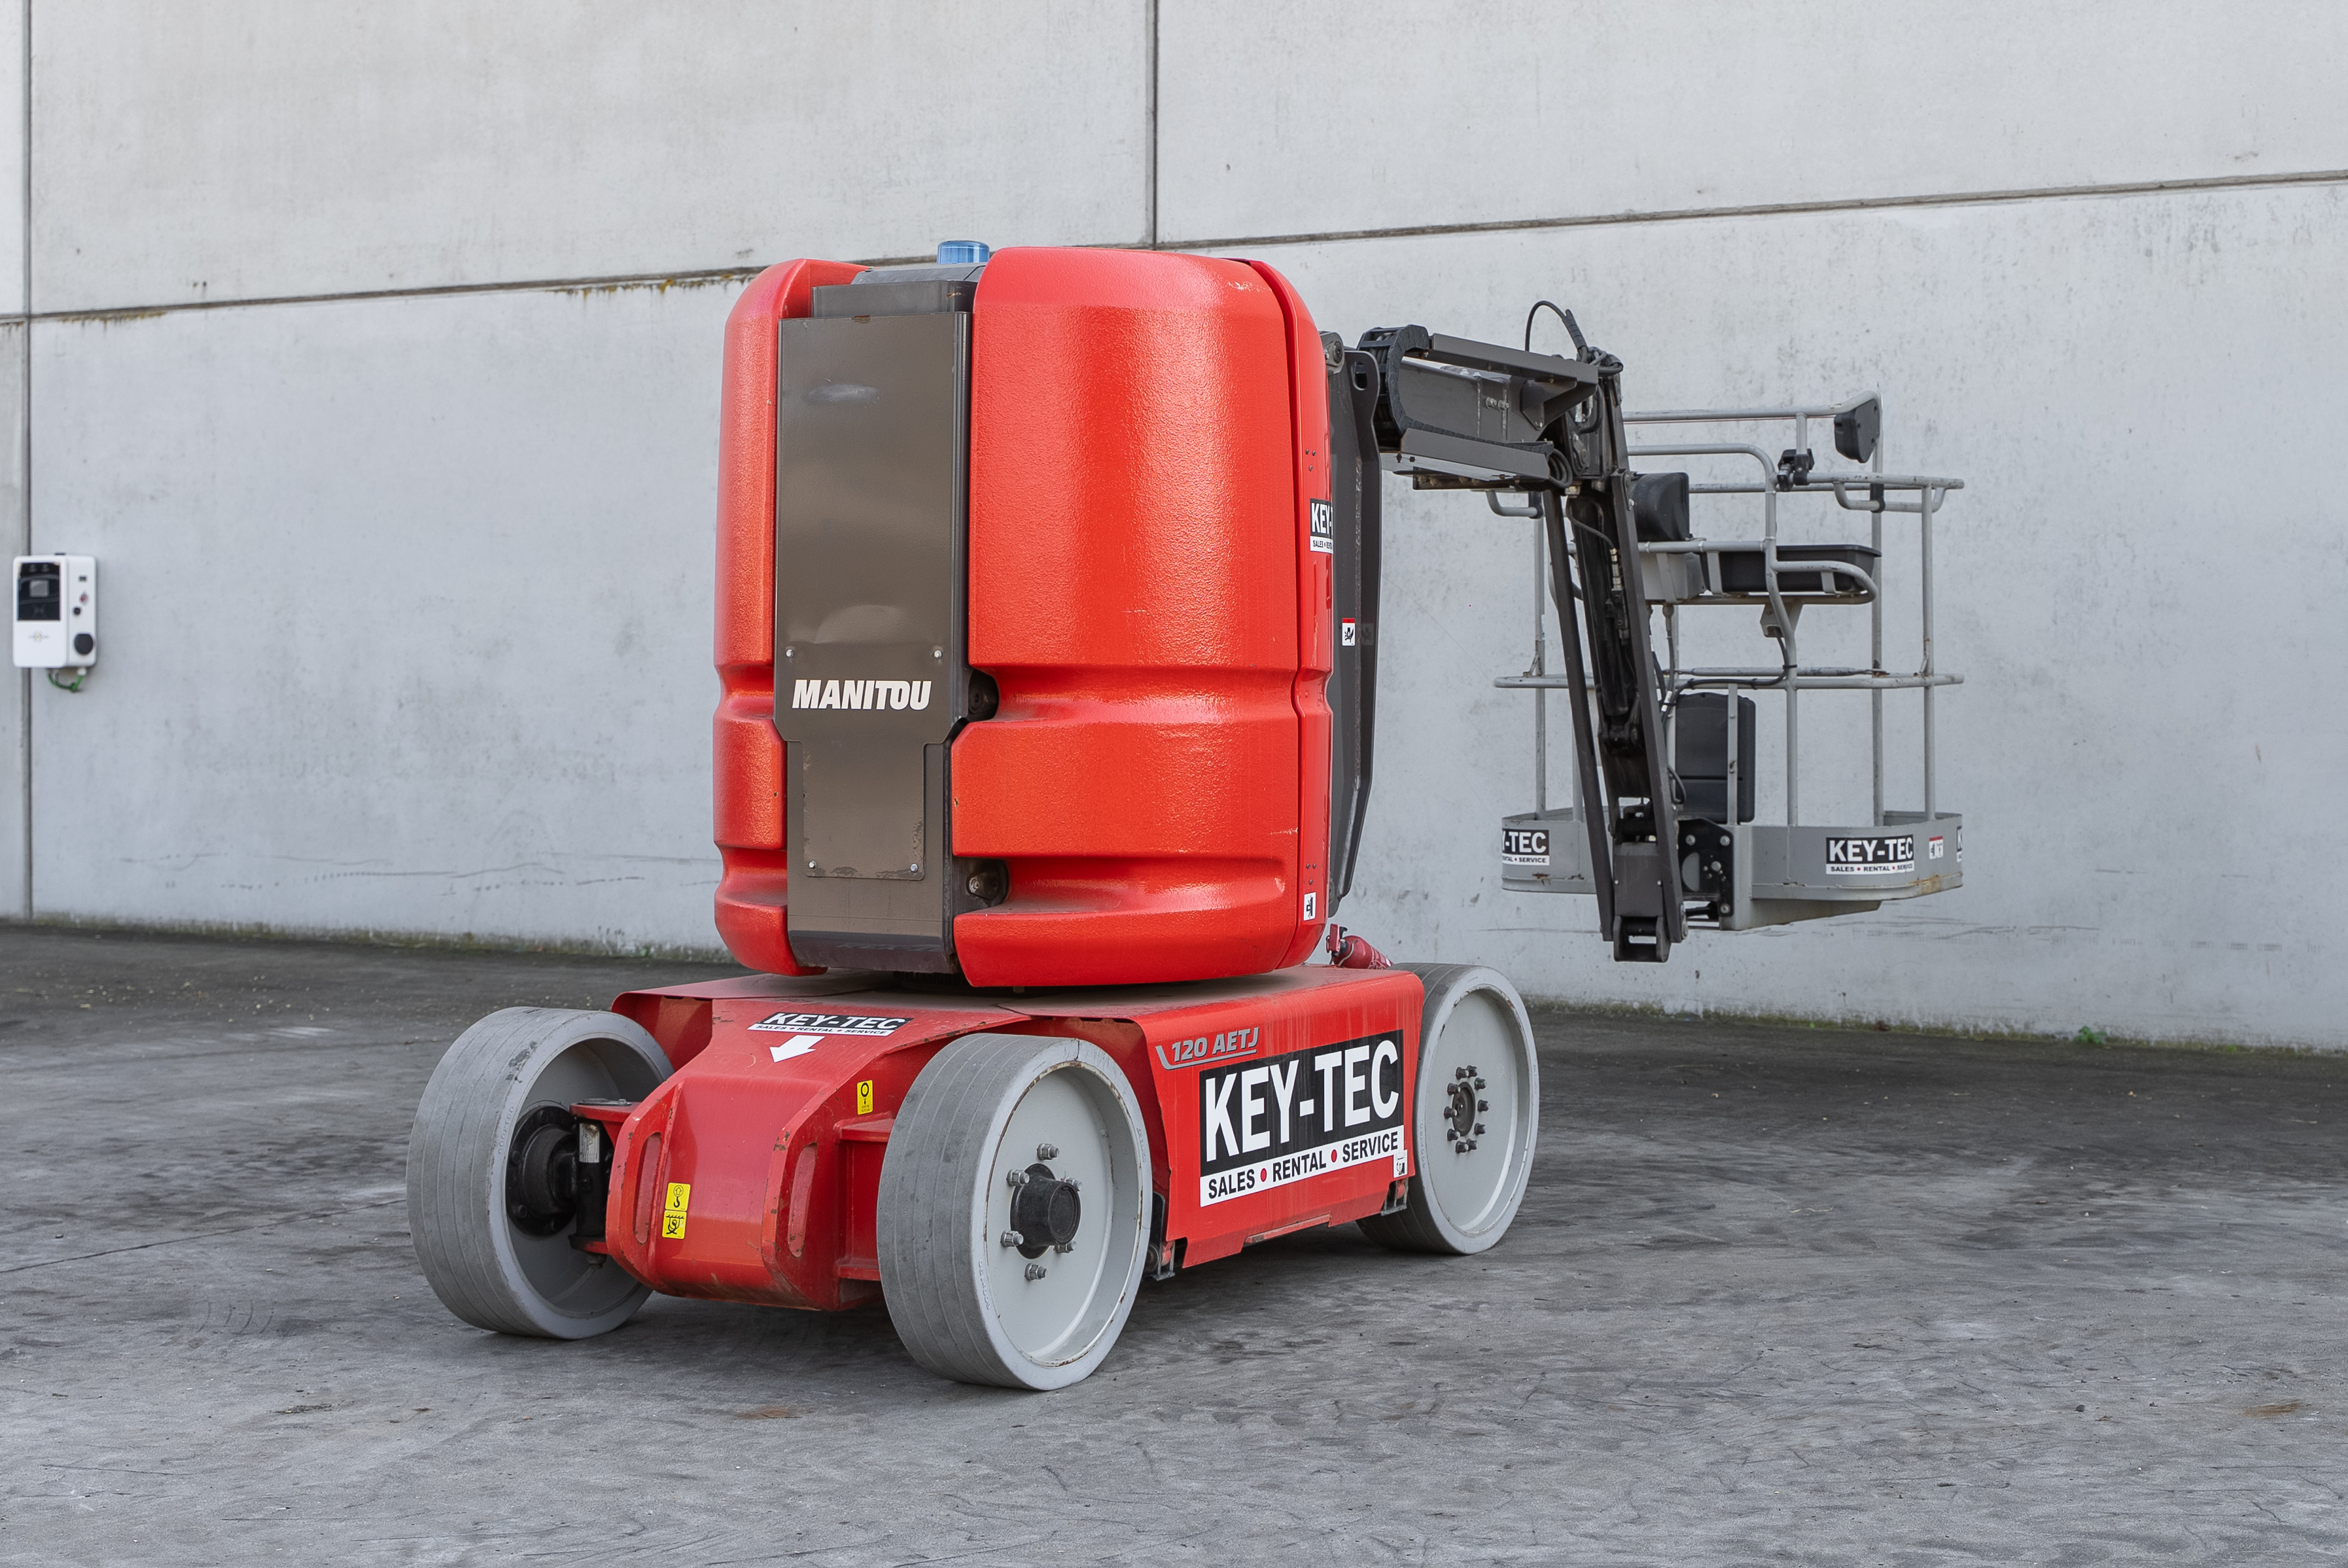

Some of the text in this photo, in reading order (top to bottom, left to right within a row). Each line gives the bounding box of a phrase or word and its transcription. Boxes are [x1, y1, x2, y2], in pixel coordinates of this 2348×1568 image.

[792, 679, 932, 710] MANITOU
[1829, 837, 1913, 862] KEY-TEC
[763, 1013, 905, 1030] KEY-TEC
[1172, 1027, 1259, 1062] 120 AETJ
[1205, 1039, 1399, 1162] KEY-TEC
[1208, 1131, 1398, 1199] SALES RENTAL SERVICE
